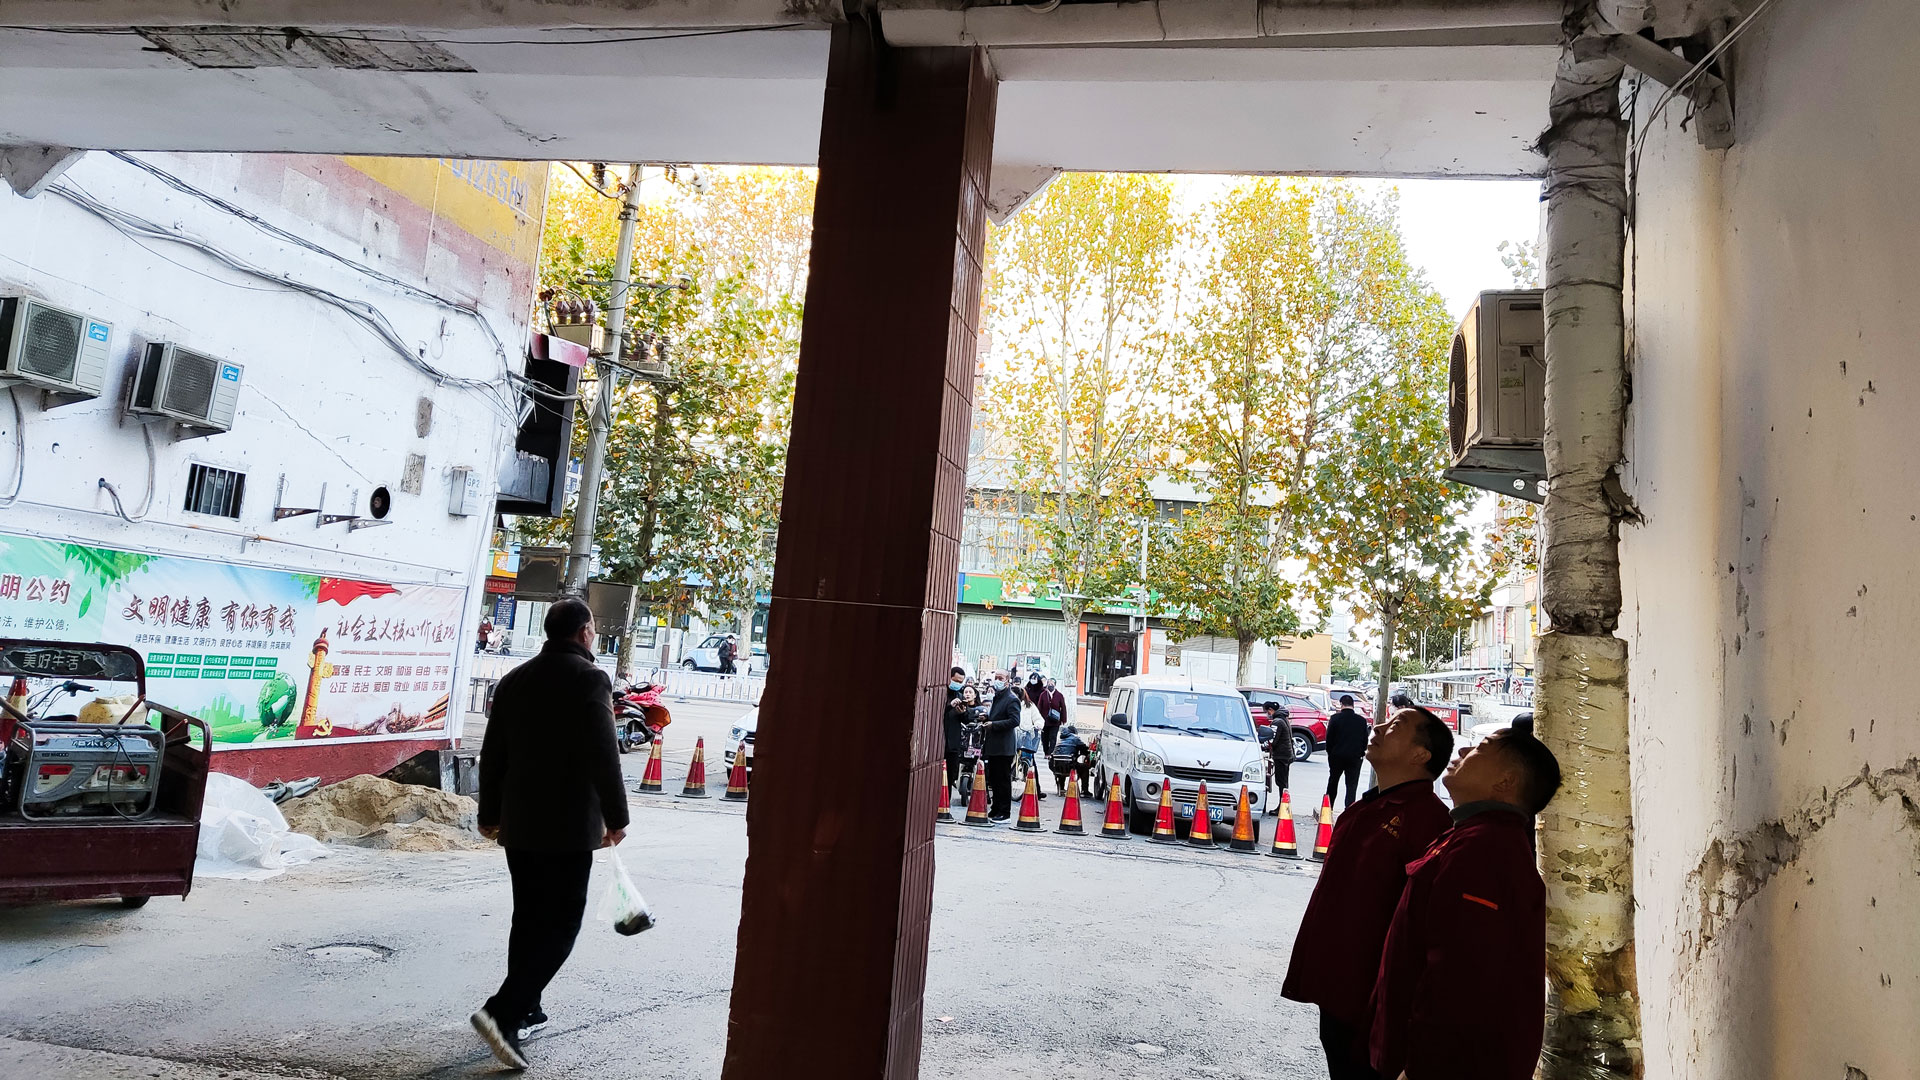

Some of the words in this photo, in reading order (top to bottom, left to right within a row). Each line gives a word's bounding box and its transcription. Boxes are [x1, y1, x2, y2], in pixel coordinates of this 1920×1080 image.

[122, 594, 212, 632] 文明健康
[220, 599, 297, 637] 有你有我
[135, 633, 161, 644] 绿色环保
[164, 635, 190, 646] 健康生活
[193, 637, 217, 648] 文明行为
[219, 638, 243, 649] 良好心态
[22, 653, 80, 671] 美好生活
[332, 664, 351, 677] 富强
[353, 665, 372, 677] 民主
[375, 665, 393, 676] 文明
[395, 665, 412, 676] 和谐
[415, 666, 431, 676] 自由
[434, 665, 449, 676] 平等
[329, 682, 348, 693] 公正
[351, 682, 370, 693] 法治
[373, 682, 391, 693] 爱国
[393, 681, 410, 692] 敬业
[412, 681, 429, 691] 诚信
[431, 681, 447, 691] 友善
